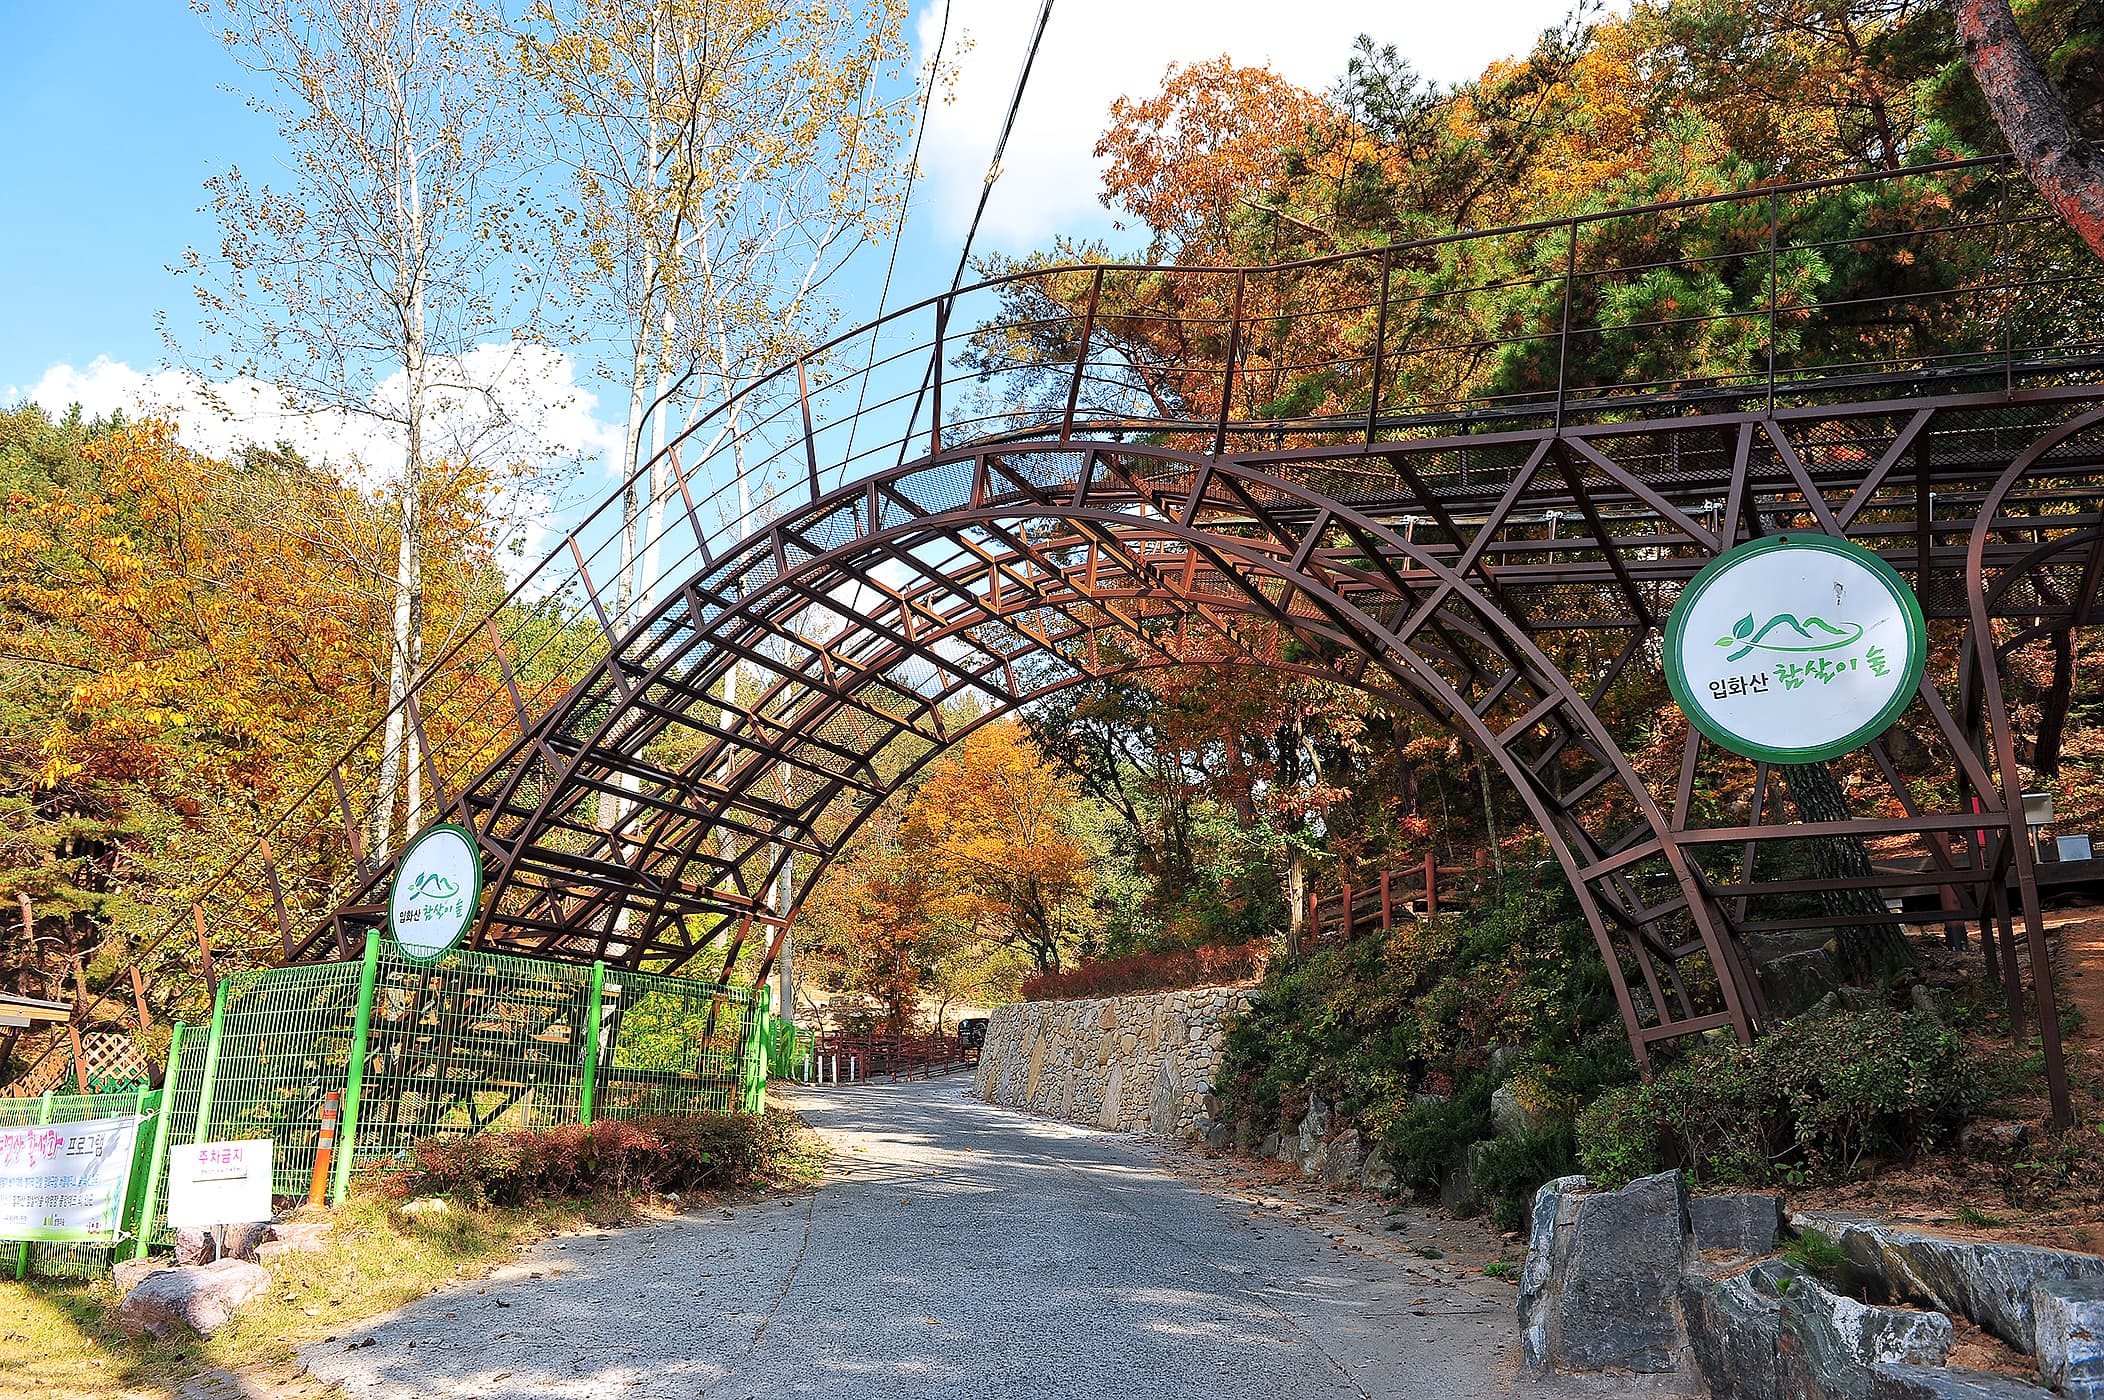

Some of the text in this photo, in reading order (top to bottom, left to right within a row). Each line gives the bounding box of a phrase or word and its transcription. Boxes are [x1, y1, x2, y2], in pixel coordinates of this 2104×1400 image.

[1708, 644, 1890, 701] 입화산 참살이 숲
[399, 898, 463, 924] 입화산 참살이 숲
[66, 1133, 104, 1157] 프로그램
[198, 1147, 243, 1165] 주차금지
